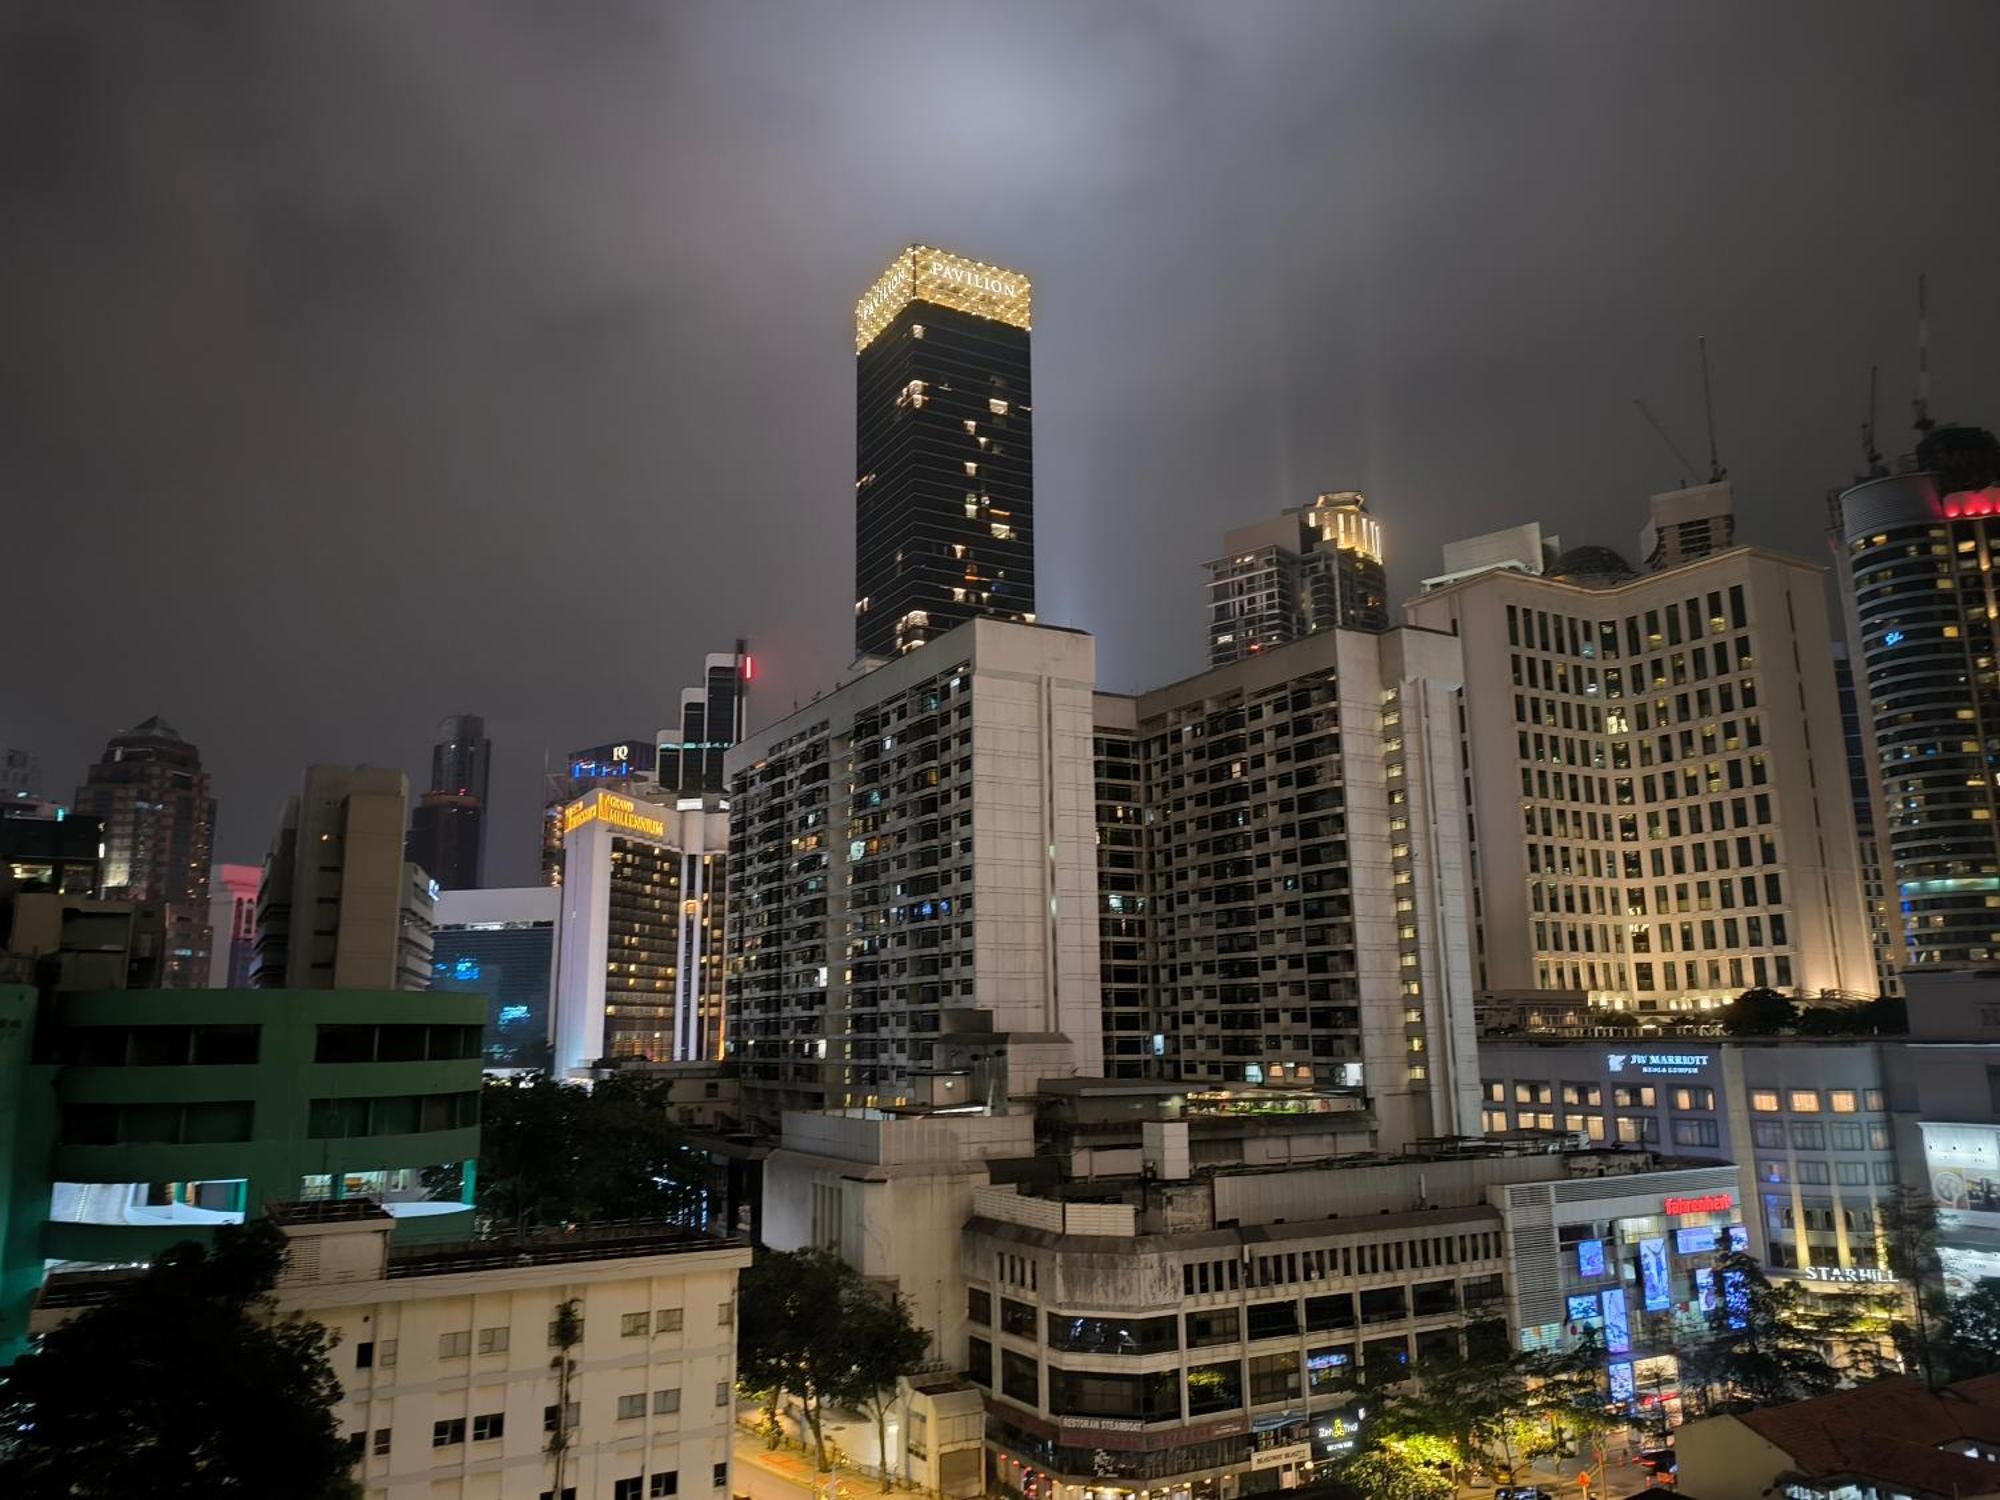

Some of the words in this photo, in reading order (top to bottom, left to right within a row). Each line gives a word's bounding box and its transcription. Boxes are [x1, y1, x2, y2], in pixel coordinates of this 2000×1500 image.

[931, 262, 1016, 297] PAVILION
[608, 808, 664, 837] MILLENNIUM
[1630, 1054, 1647, 1065] JW
[1648, 1055, 1709, 1065] MARRIOTT
[1062, 1417, 1100, 1430] RESTORAN
[1101, 1419, 1143, 1432] STEAMBOAT
